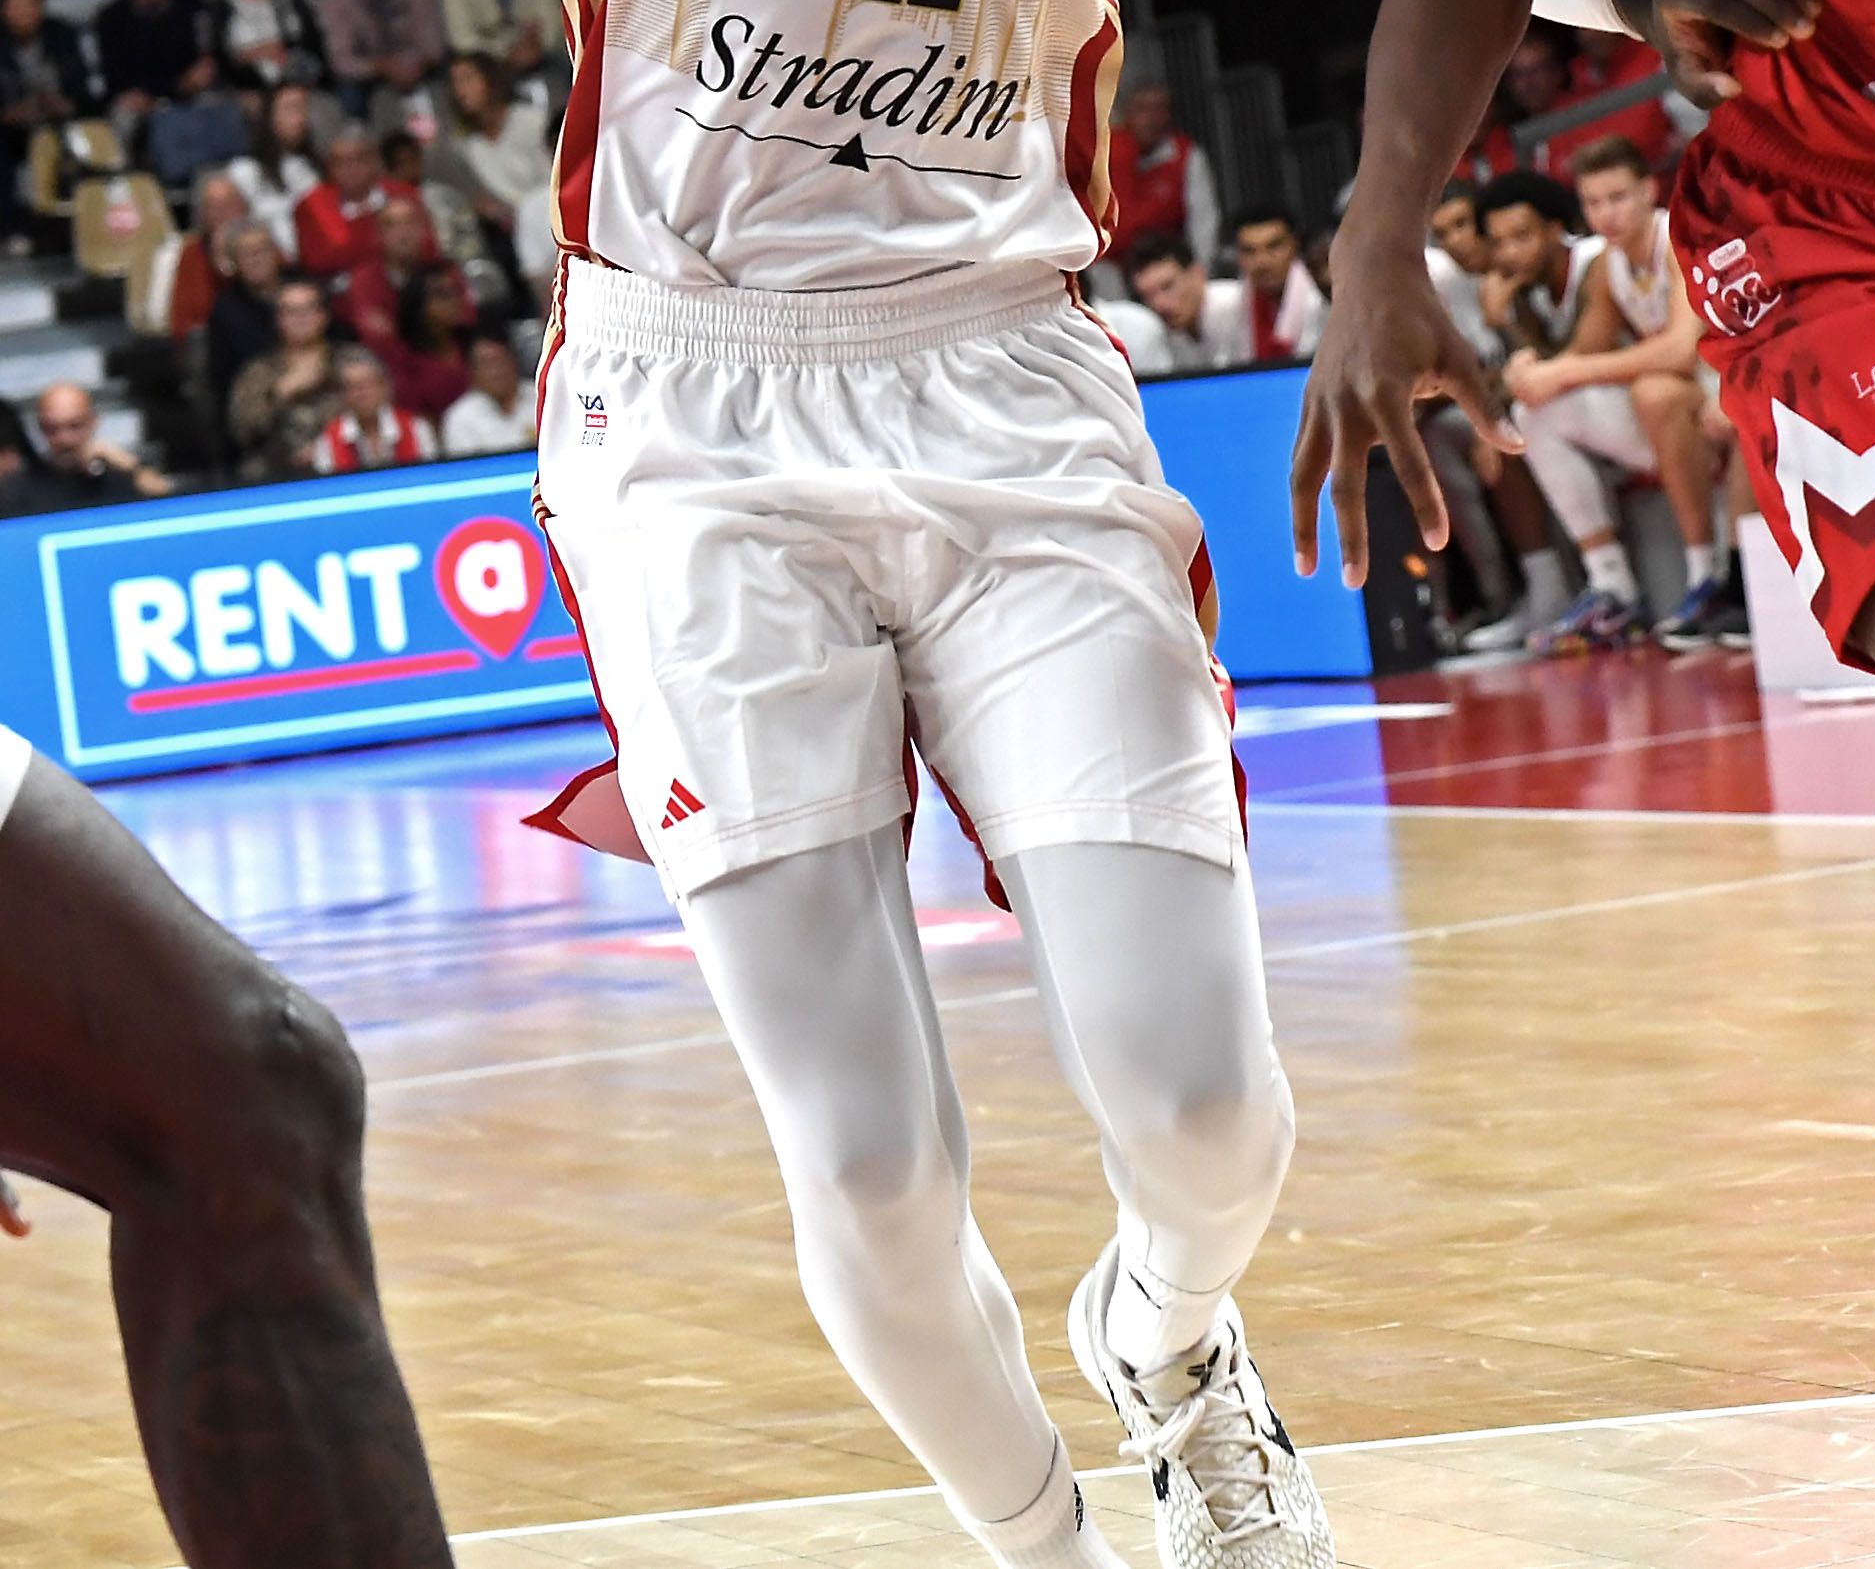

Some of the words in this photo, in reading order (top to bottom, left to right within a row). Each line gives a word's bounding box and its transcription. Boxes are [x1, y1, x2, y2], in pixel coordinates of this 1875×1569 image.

[696, 15, 1021, 140] Stradim
[110, 543, 420, 688] RENT
[455, 539, 528, 617] a
